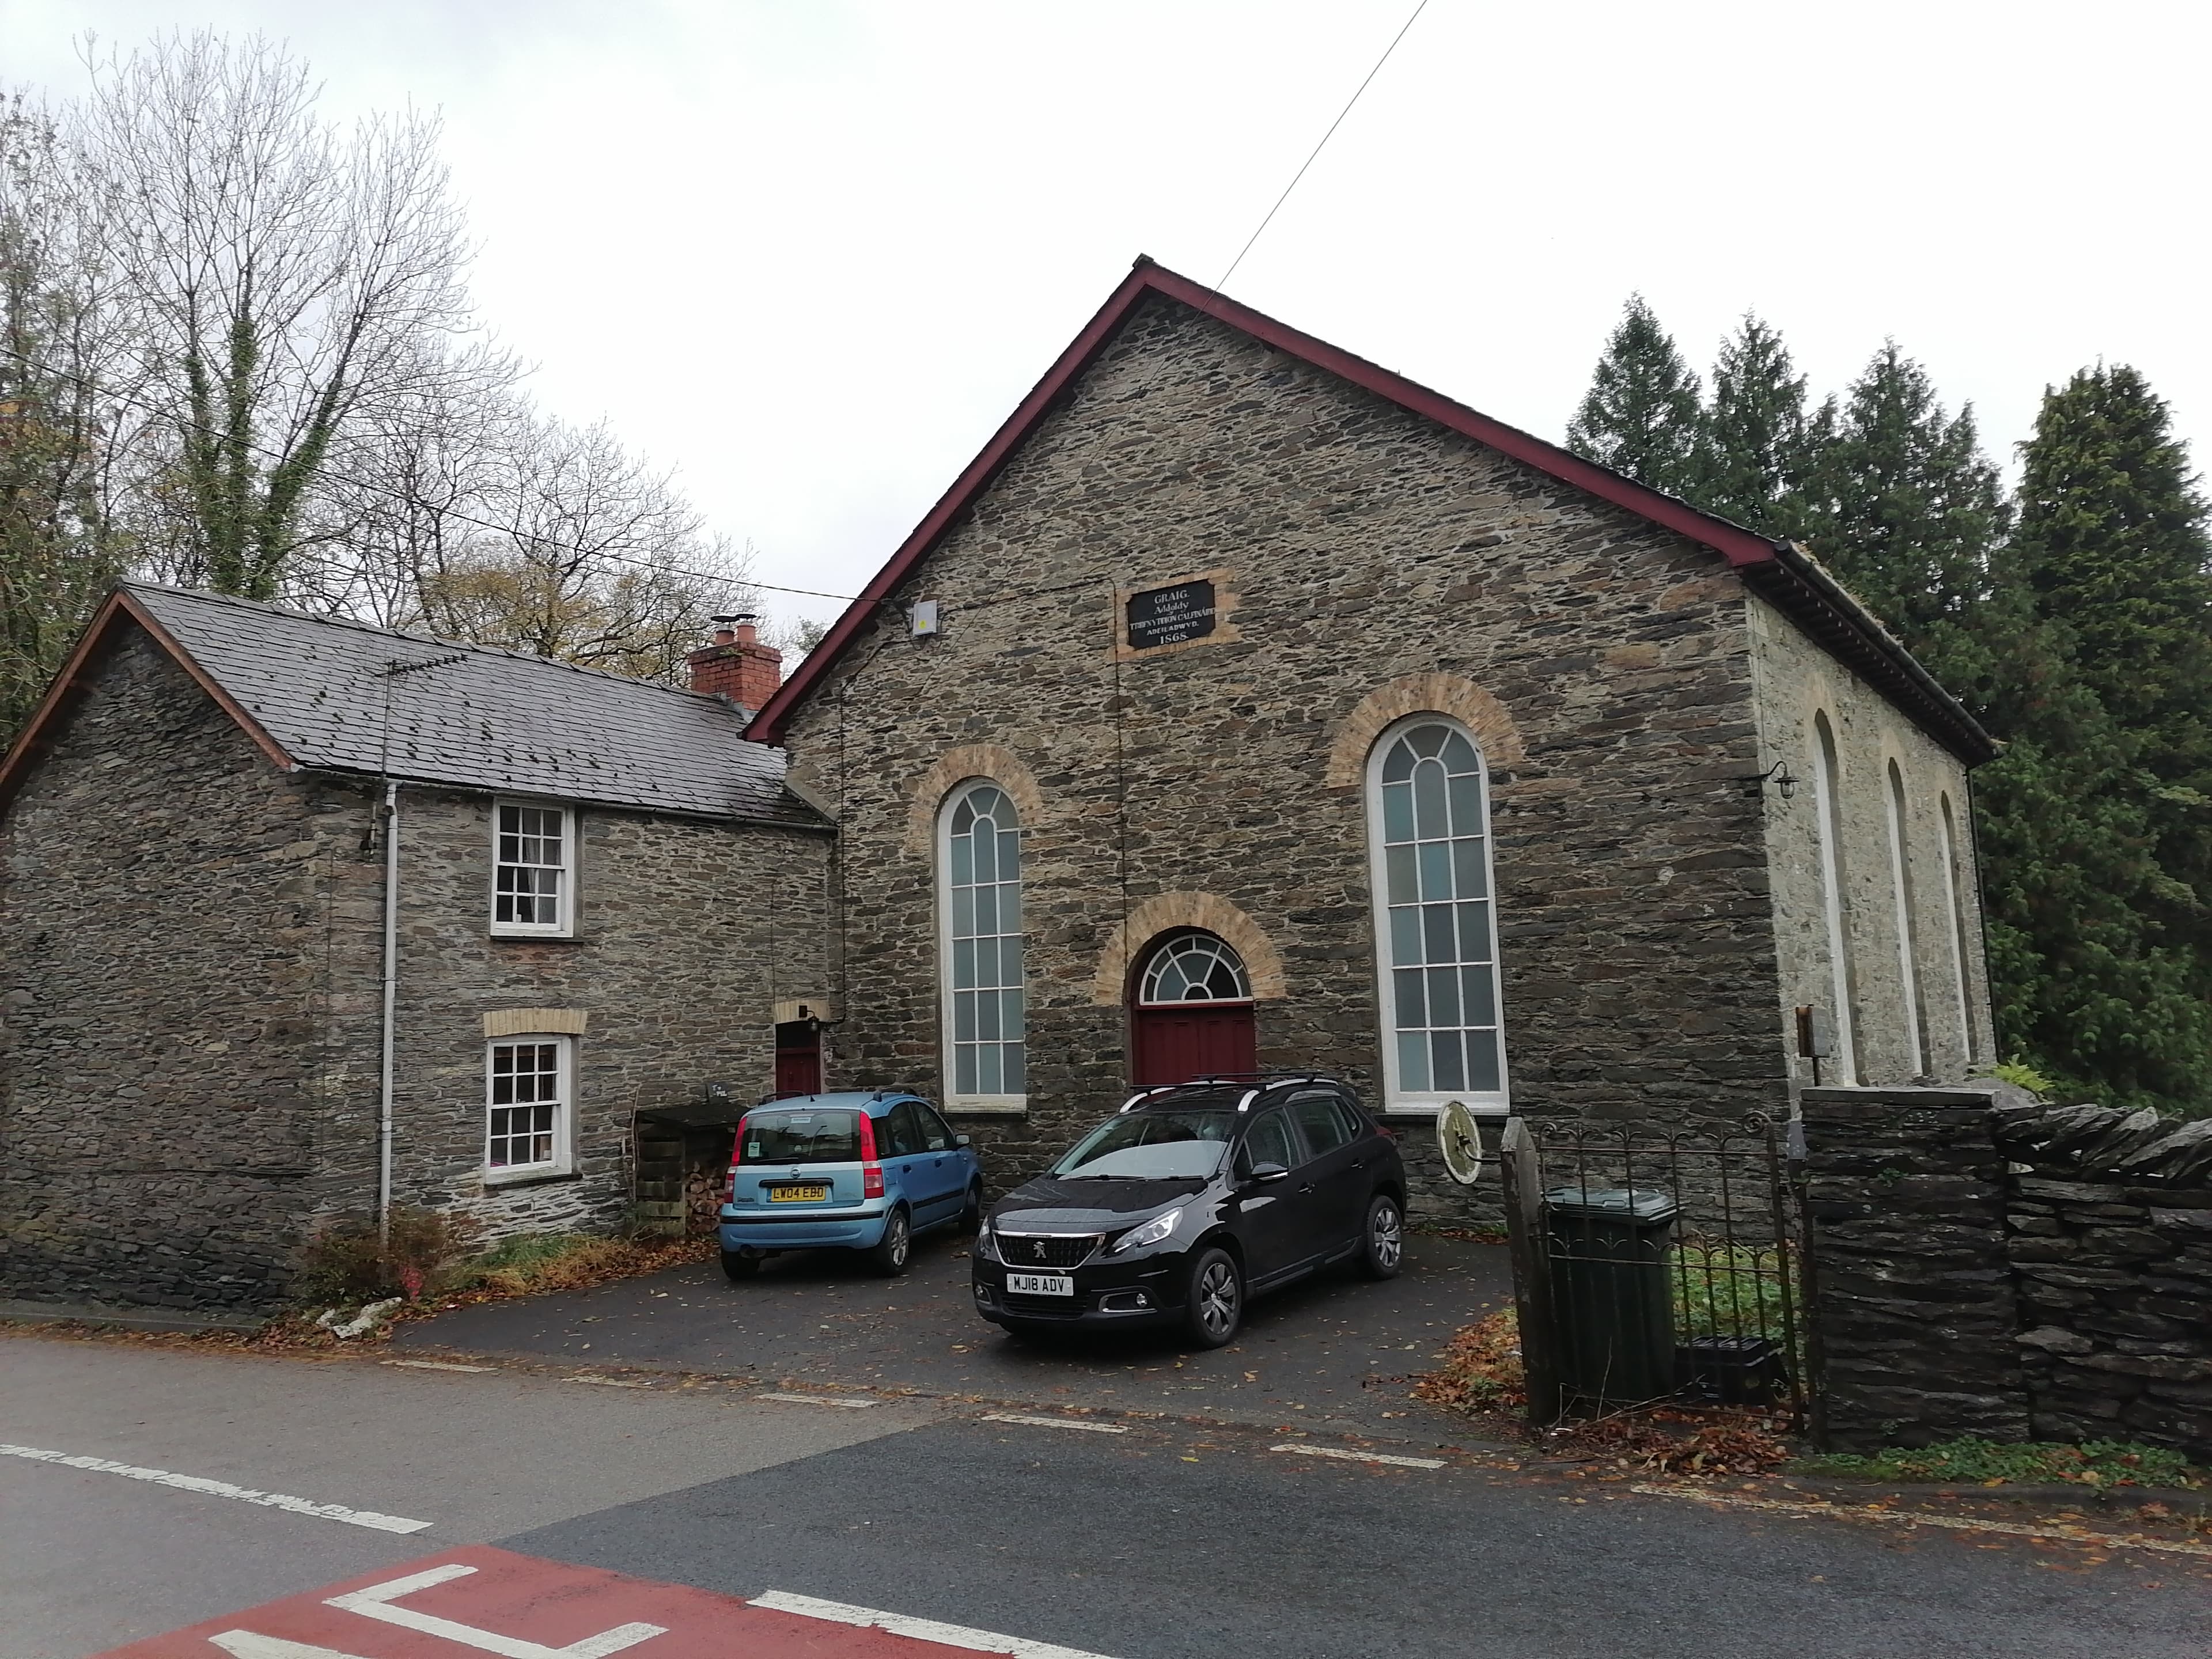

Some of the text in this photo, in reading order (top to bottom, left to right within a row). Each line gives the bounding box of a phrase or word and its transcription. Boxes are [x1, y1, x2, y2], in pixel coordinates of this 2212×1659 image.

[773, 1187, 824, 1199] LW04 EBD
[1014, 1276, 1065, 1292] MJ18 ADV
